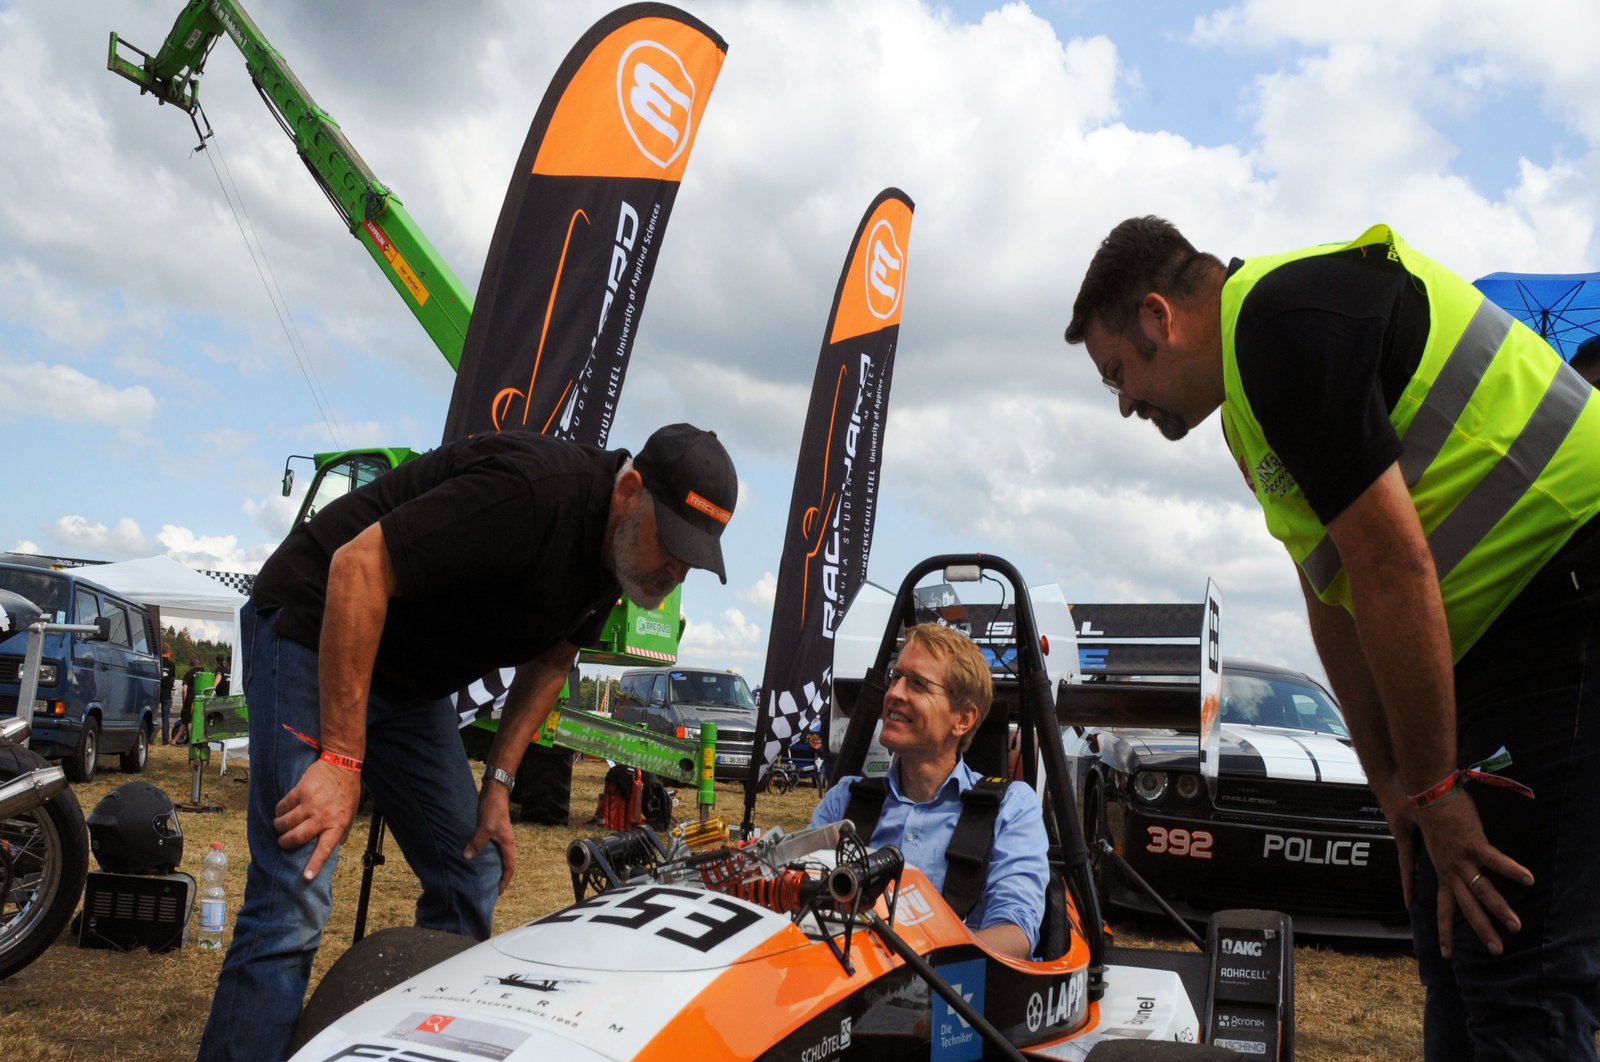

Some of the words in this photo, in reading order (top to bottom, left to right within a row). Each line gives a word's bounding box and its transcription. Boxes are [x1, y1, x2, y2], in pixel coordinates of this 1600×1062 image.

[367, 222, 386, 246] ZEPPELIN
[643, 203, 661, 245] Sciences
[631, 246, 648, 287] Applied
[629, 287, 637, 301] of
[616, 302, 635, 357] University
[607, 366, 621, 397] KIEL
[874, 411, 880, 420] of
[869, 421, 880, 463] University
[867, 470, 876, 494] KIEL
[1146, 826, 1214, 859] 392
[1262, 833, 1371, 866] POLICE
[525, 886, 765, 953] E53
[1232, 940, 1262, 957] AKG
[1220, 967, 1268, 980] ROHACELL
[402, 986, 625, 1034] KNIERIM
[476, 999, 513, 1010] YACHTS
[515, 1006, 547, 1018] SINCE
[1046, 973, 1083, 1028] LAPP
[941, 1024, 952, 1035] Die
[941, 1032, 973, 1048] Techniker
[801, 1034, 841, 1062] SCHLÖTEL
